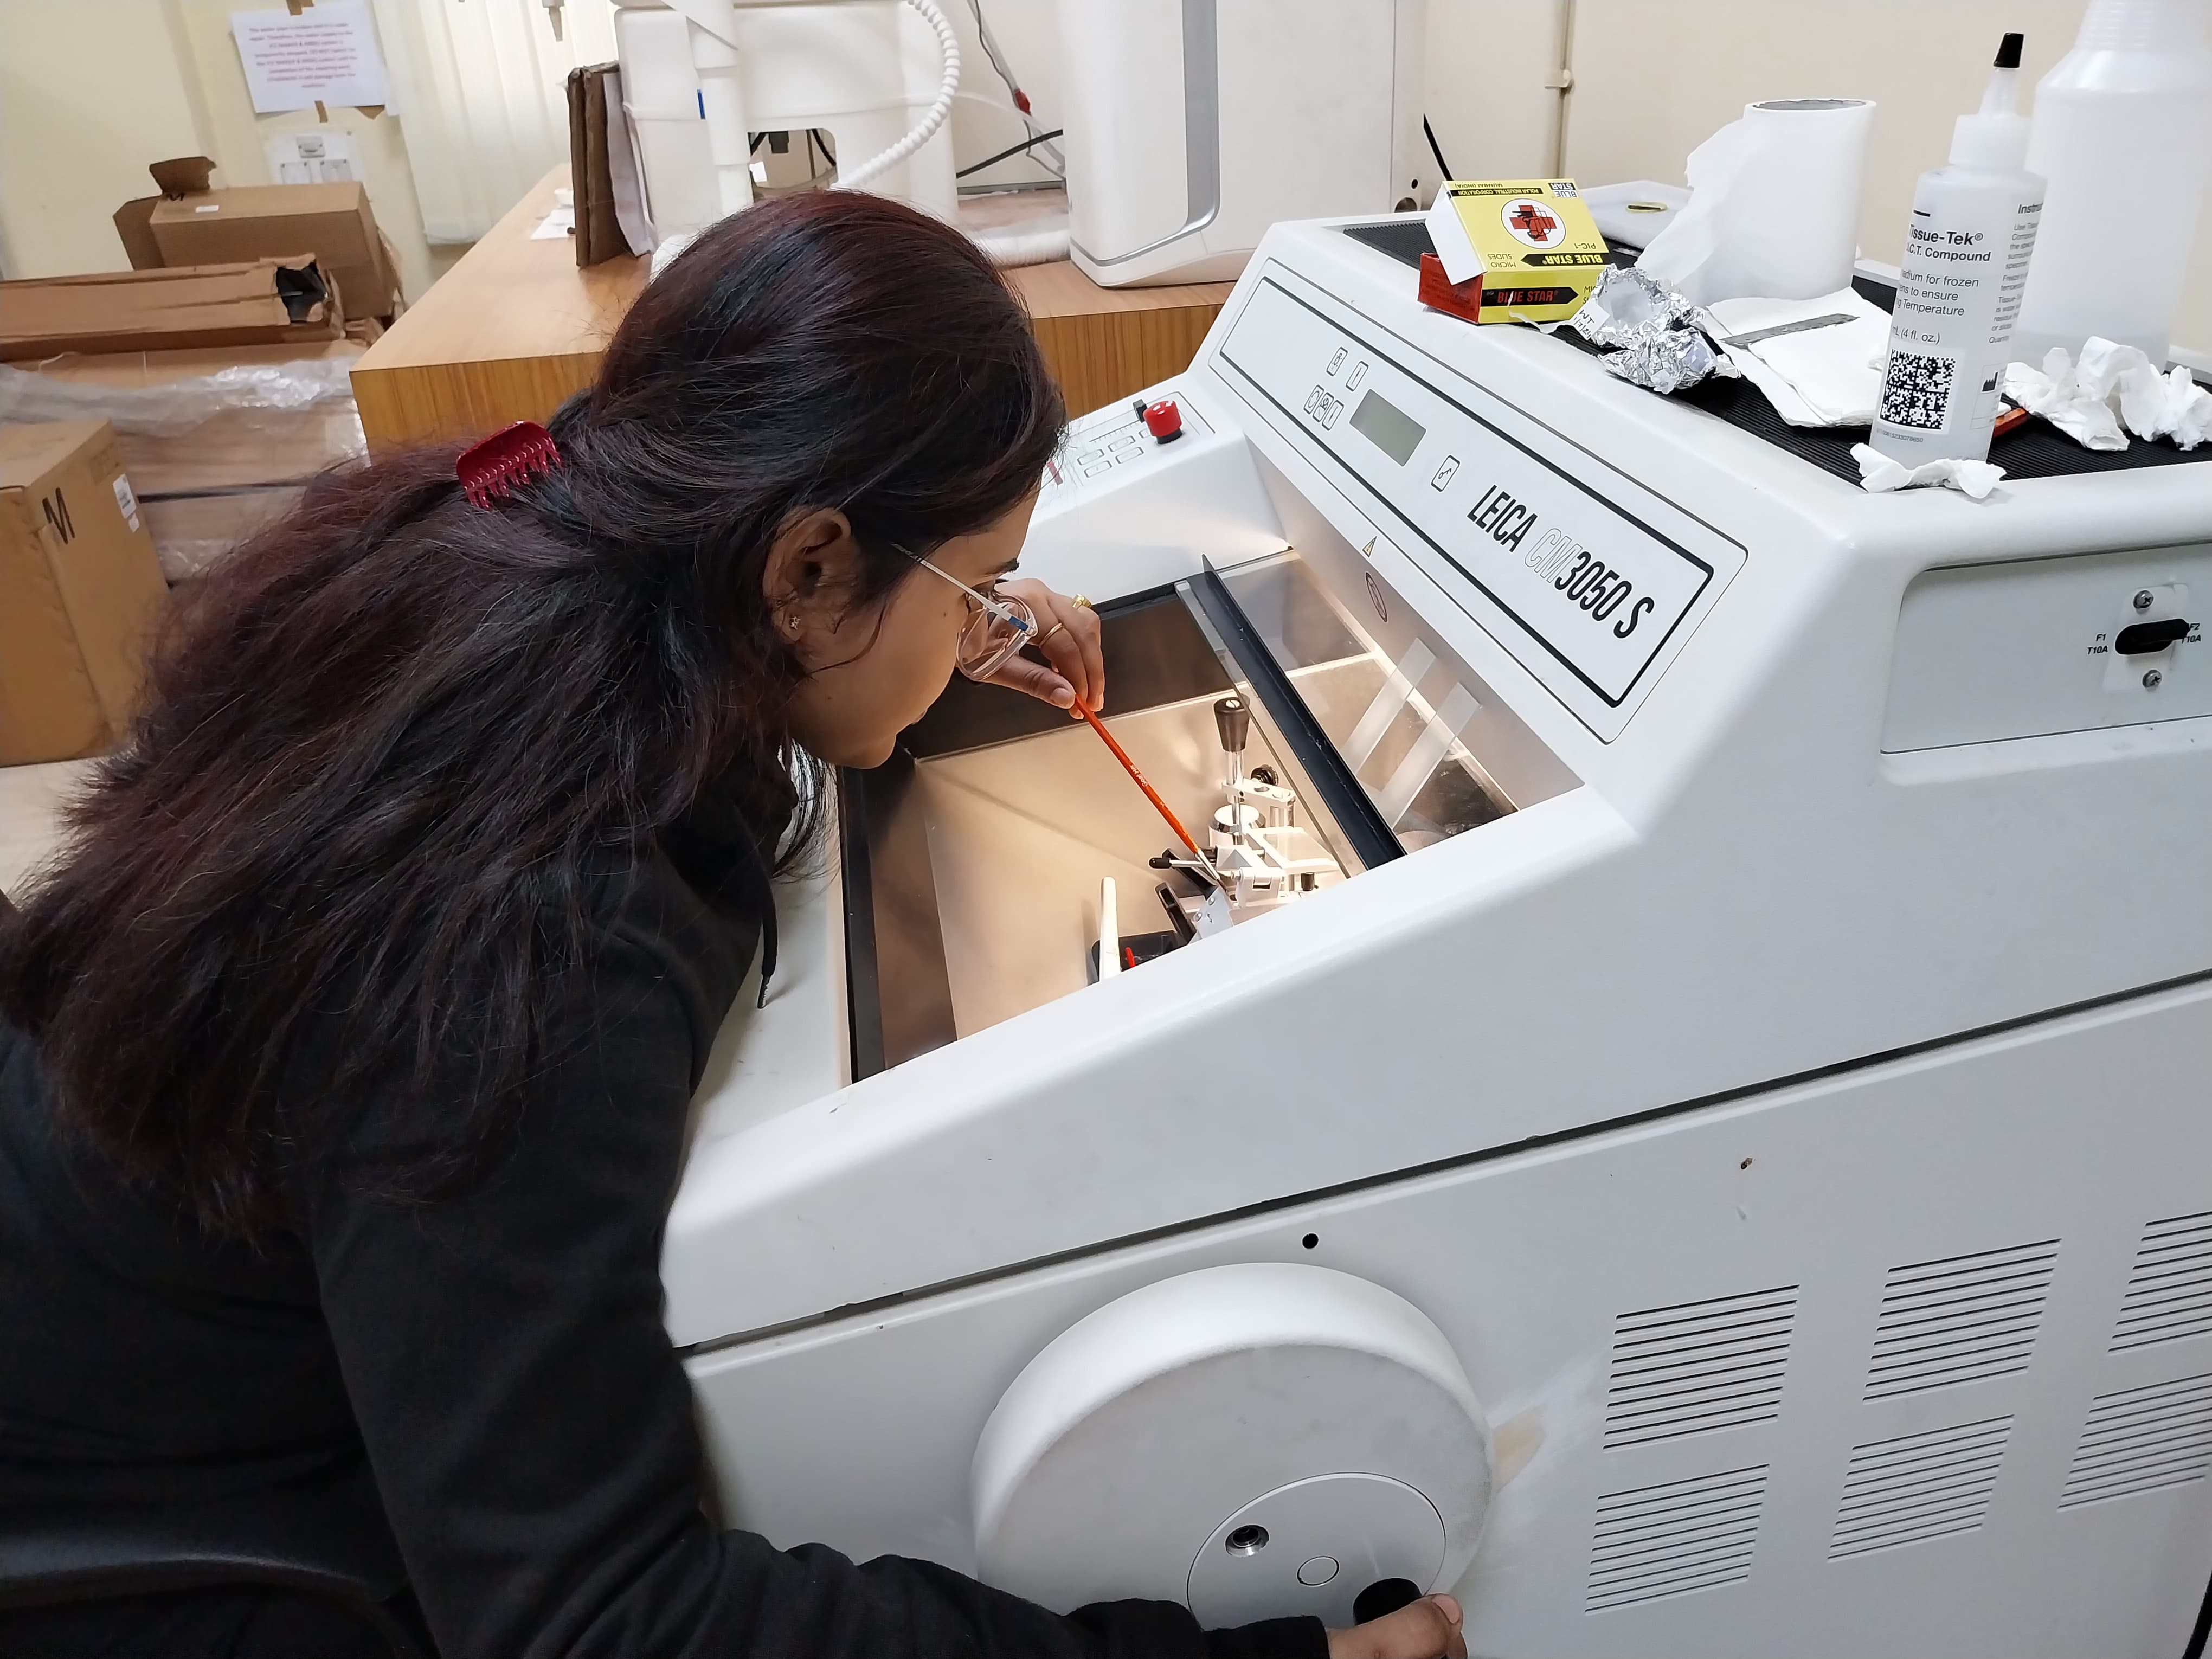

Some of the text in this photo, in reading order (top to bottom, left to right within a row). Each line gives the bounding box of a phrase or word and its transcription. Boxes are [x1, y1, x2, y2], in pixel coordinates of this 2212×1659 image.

[1577, 254, 1603, 263] BLUE
[1925, 247, 1991, 262] Compound
[1926, 273, 1940, 285] for
[1943, 275, 1979, 287] frozen
[1911, 286, 1919, 297] to
[1921, 290, 1959, 301] ensure
[1903, 298, 1965, 316] Temperature
[1578, 309, 1595, 324] WT
[1901, 327, 1908, 339] (4
[1921, 332, 1940, 345] oz.)
[1467, 485, 1655, 639] LEICA CM3050 S
[2096, 633, 2106, 642] F1
[2087, 645, 2108, 655] T10A
